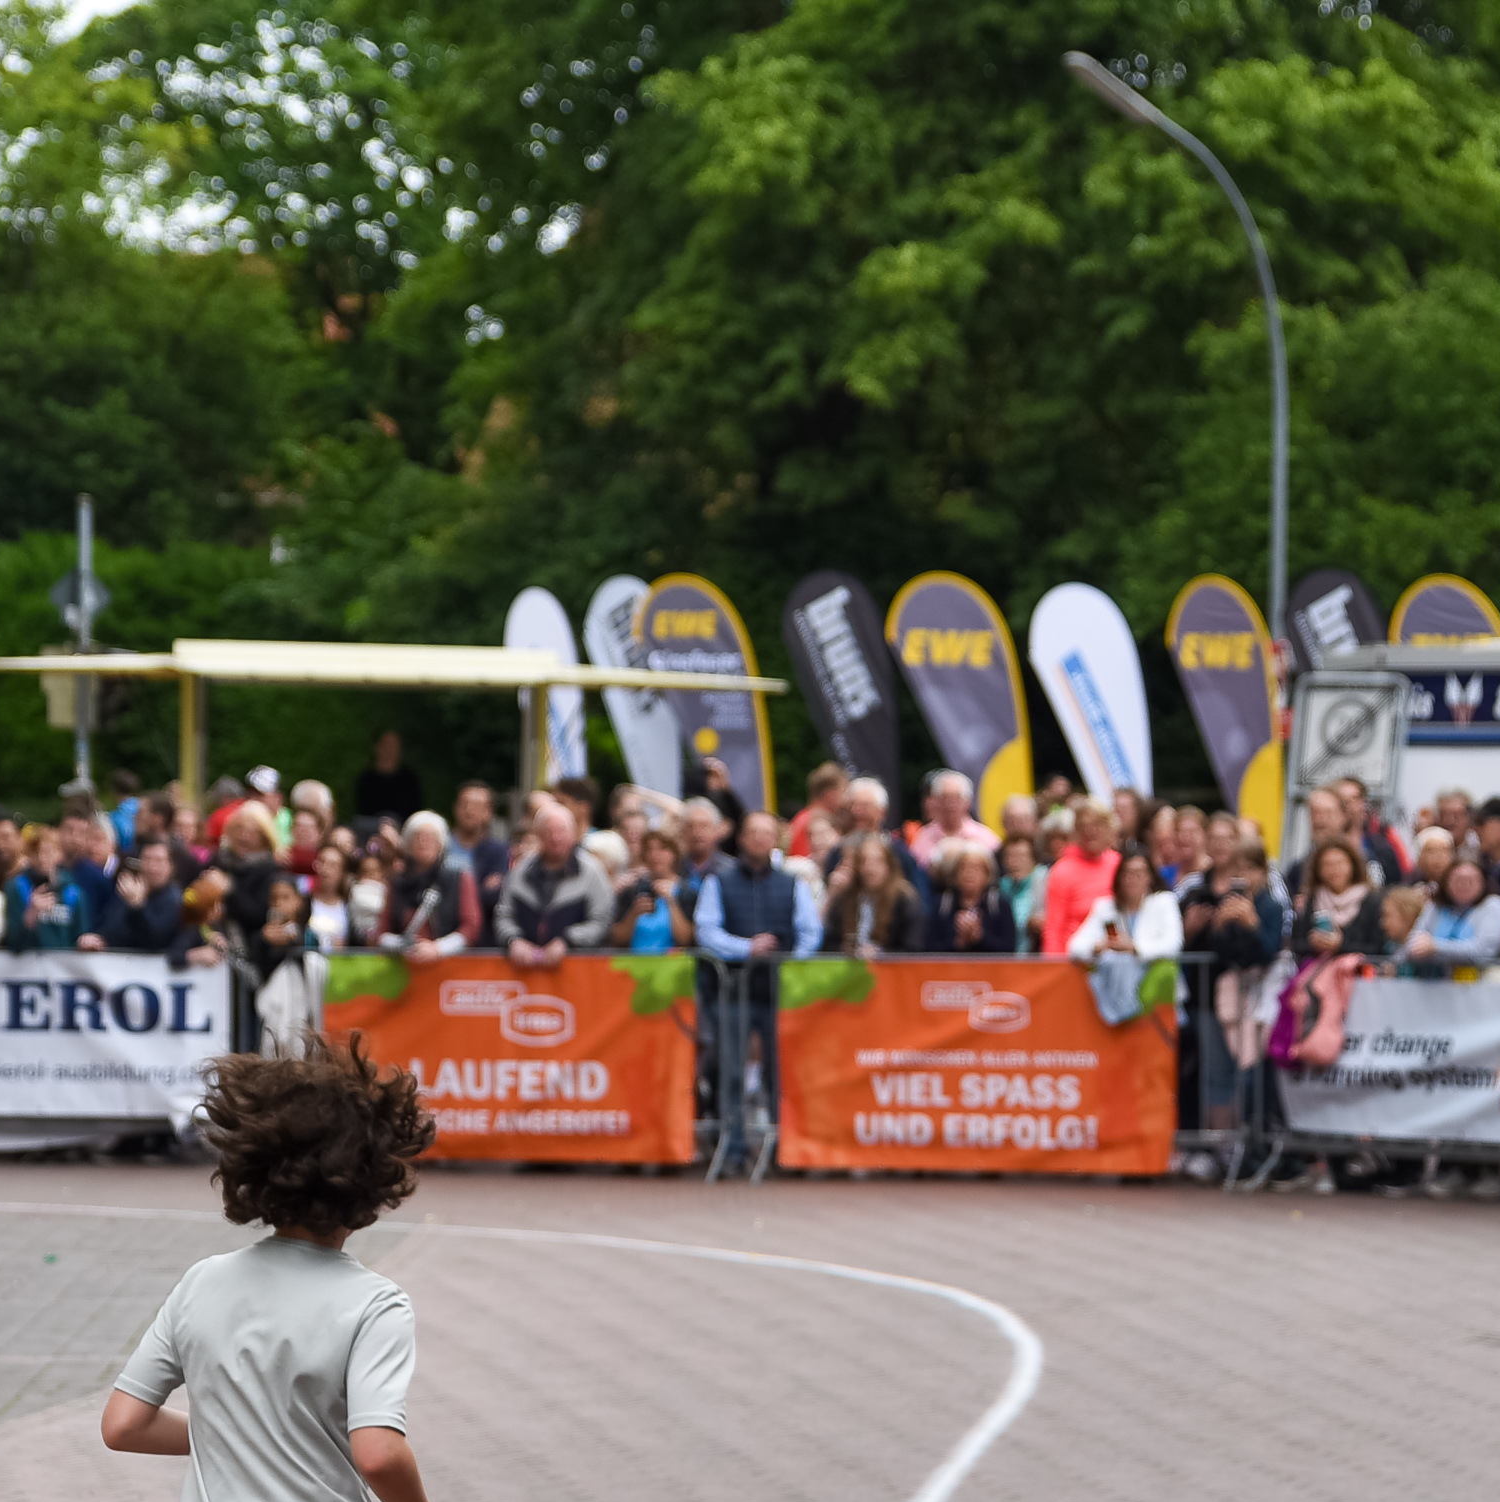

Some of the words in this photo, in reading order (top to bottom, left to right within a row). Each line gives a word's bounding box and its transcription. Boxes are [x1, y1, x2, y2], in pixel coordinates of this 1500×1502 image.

[652, 609, 717, 641] EWE
[902, 628, 995, 669] EWE
[1180, 631, 1256, 671] EWE
[1372, 1025, 1454, 1065] change
[409, 1057, 610, 1101] LAUFEND
[869, 1071, 953, 1108] VIEL
[959, 1072, 1082, 1110] SPASS
[853, 1111, 935, 1147] UND
[942, 1112, 1099, 1150] ERFOLG!
